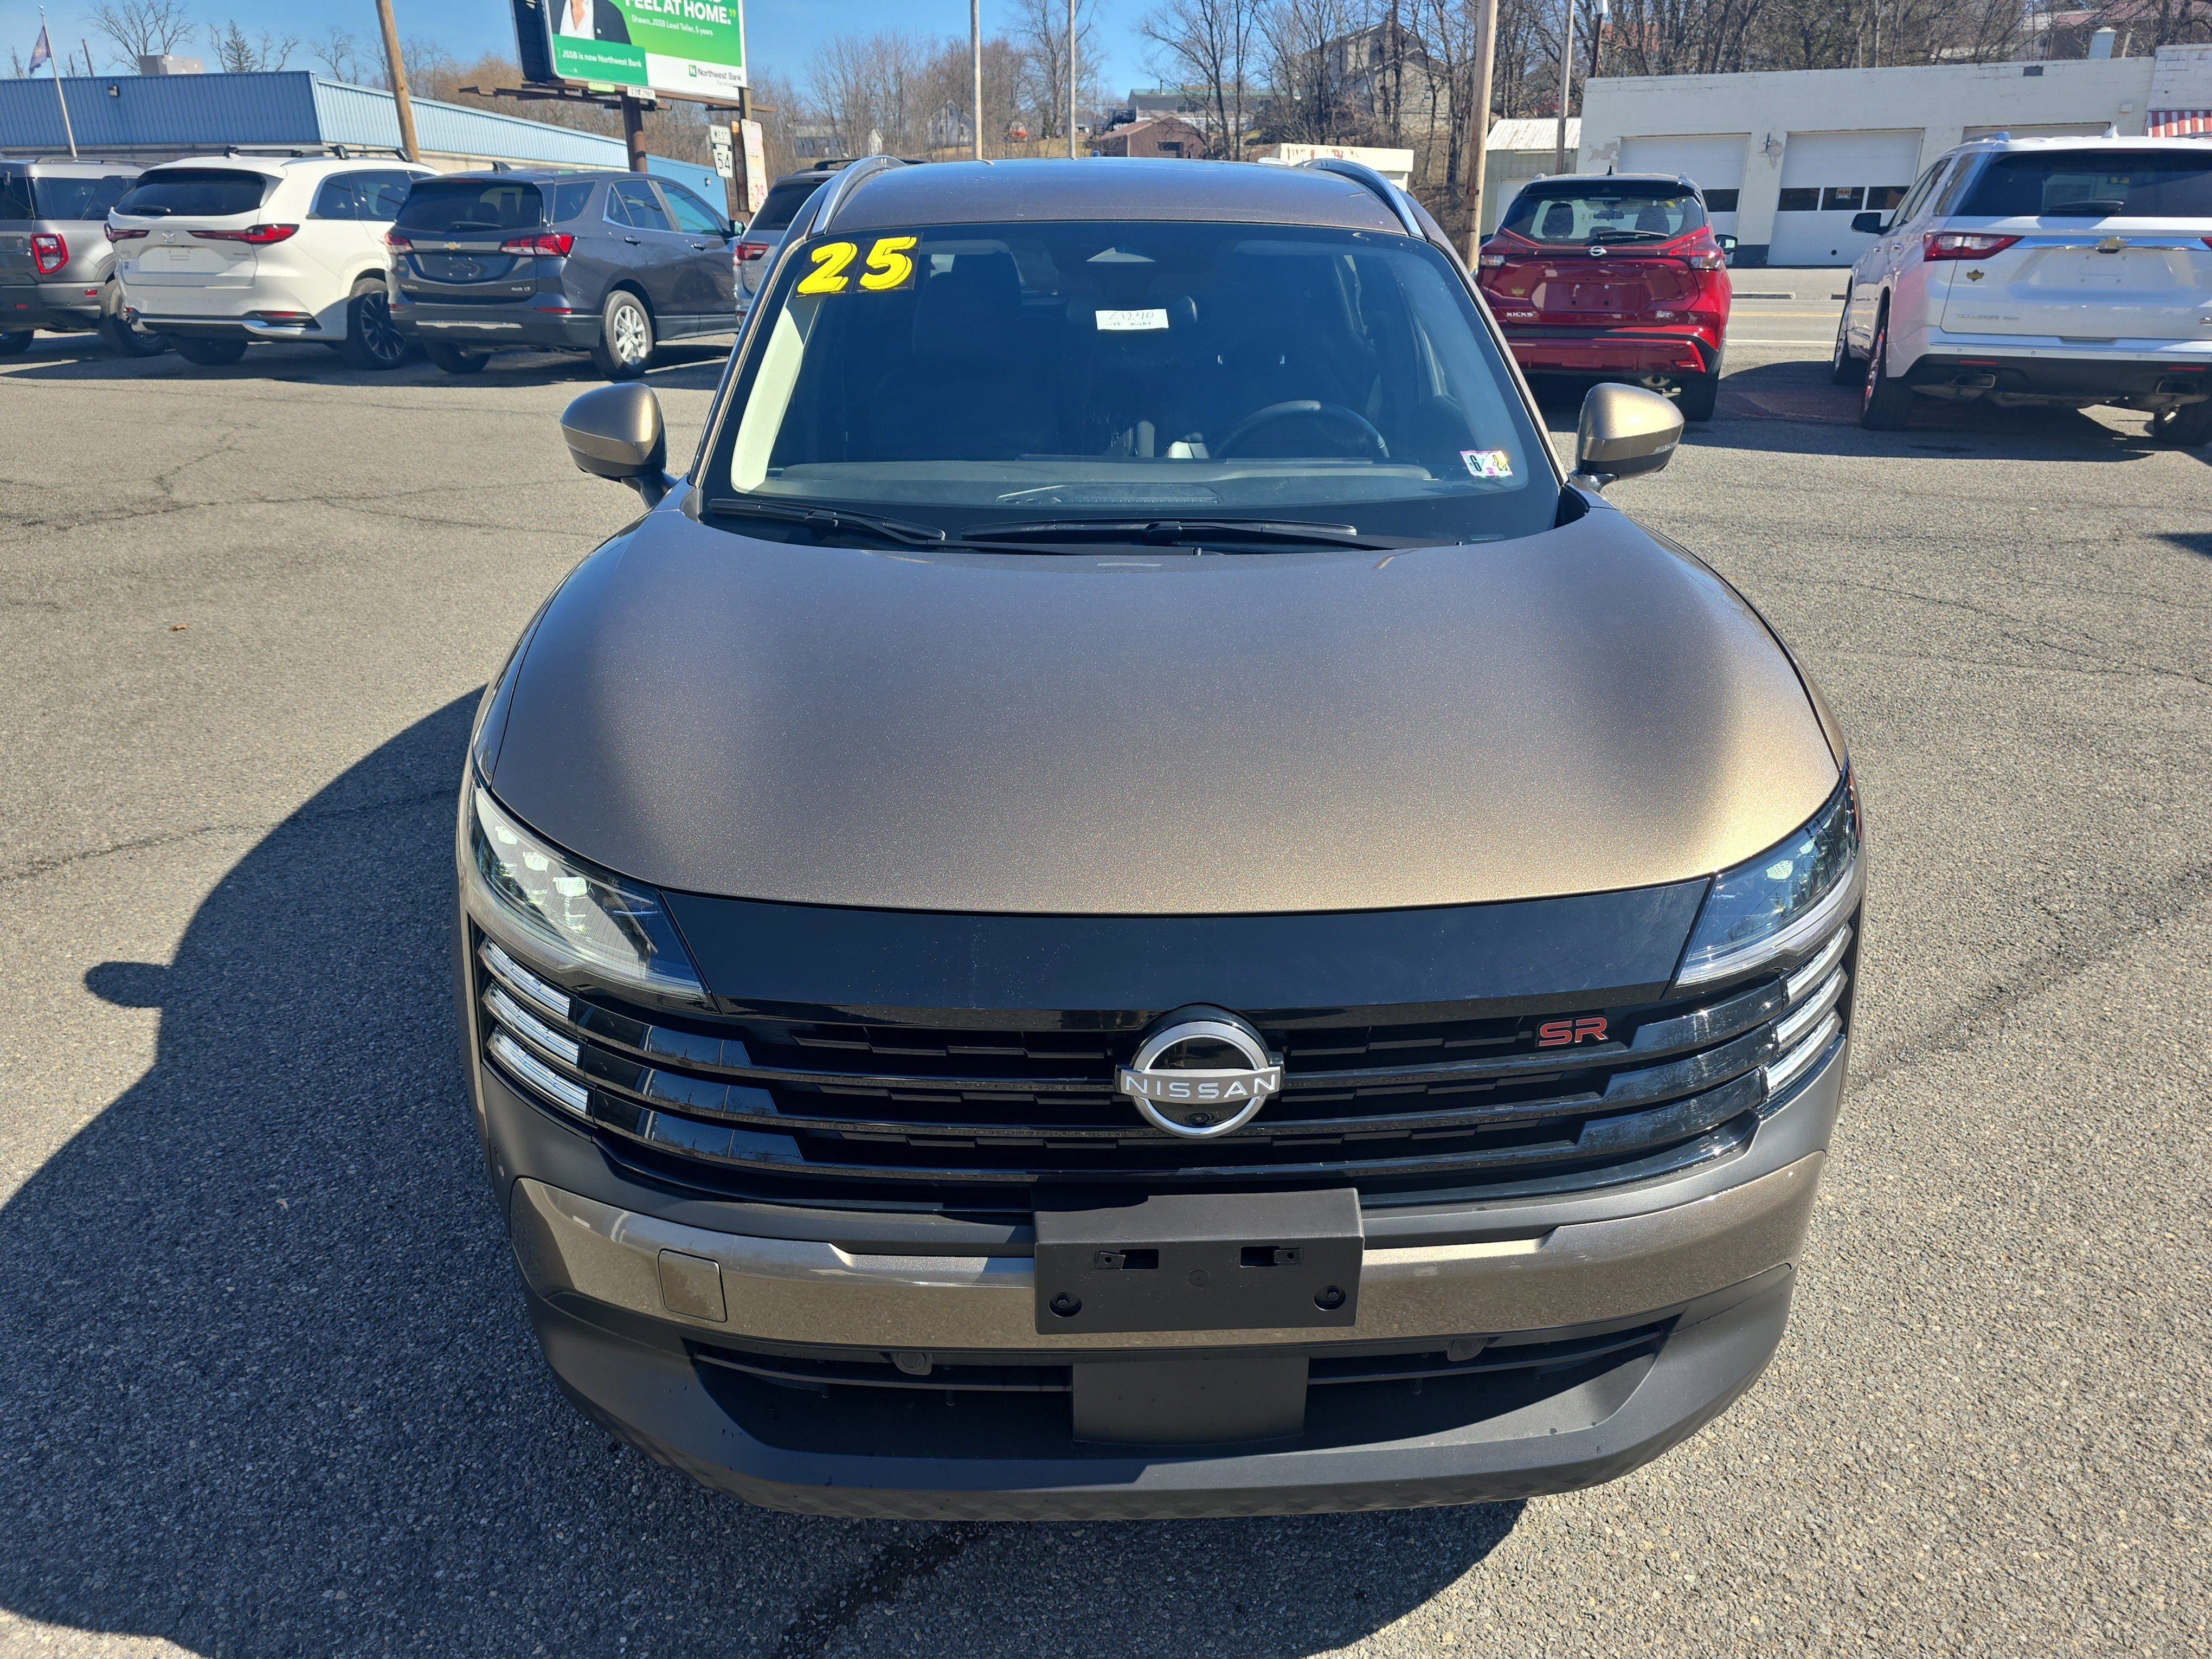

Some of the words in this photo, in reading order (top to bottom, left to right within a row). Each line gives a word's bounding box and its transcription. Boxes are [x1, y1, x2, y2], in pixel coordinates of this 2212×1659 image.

[663, 0, 680, 16] AT
[666, 21, 680, 29] Lead
[578, 52, 584, 60] is
[597, 54, 628, 66] Northwest
[628, 57, 642, 68] Bank
[698, 68, 727, 79] Northwest
[728, 72, 742, 81] Bank
[717, 152, 731, 170] 54
[798, 236, 917, 294] 25
[1538, 1017, 1609, 1047] SR
[1126, 1073, 1276, 1099] NISSAN
